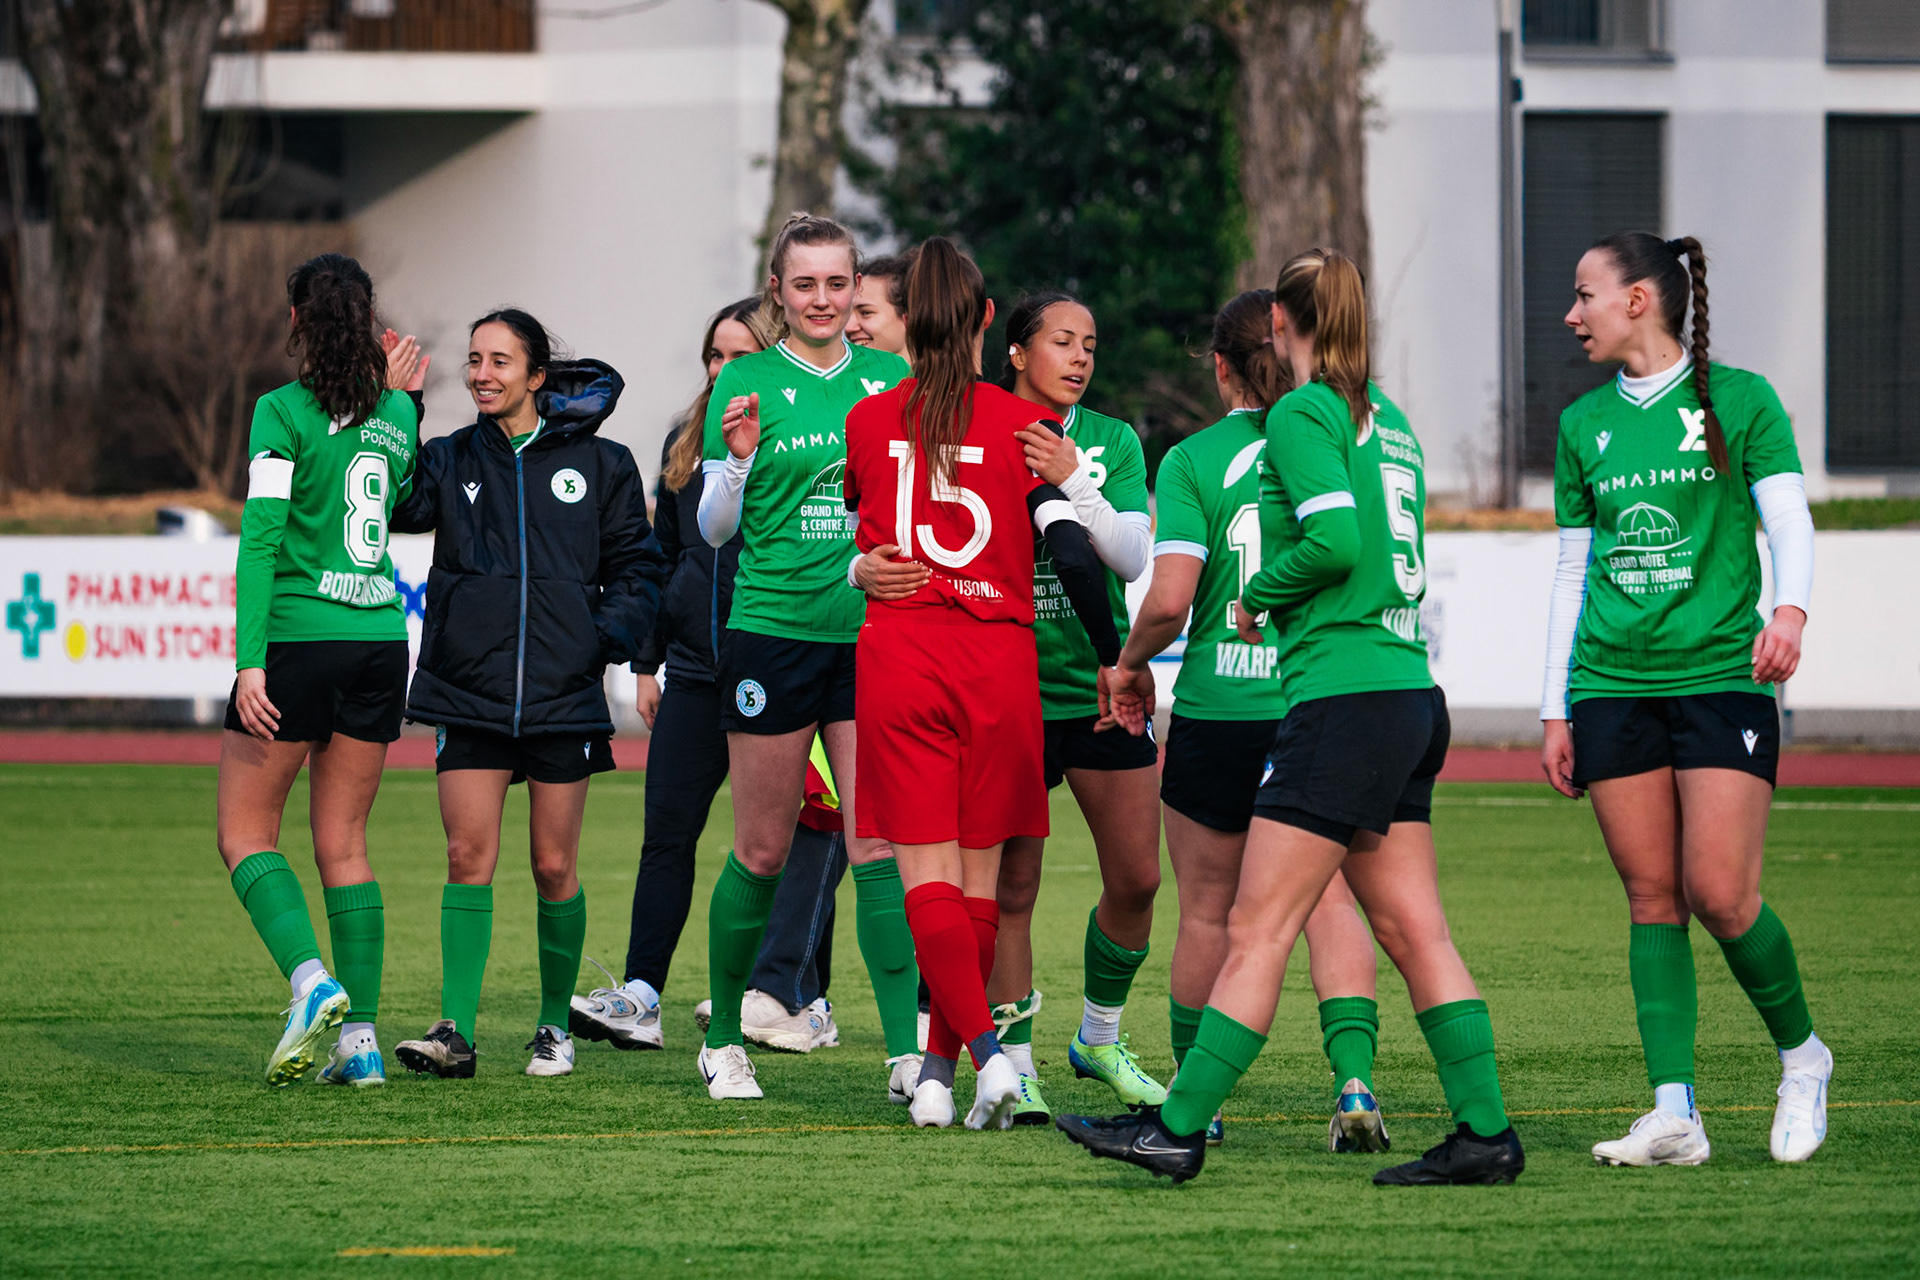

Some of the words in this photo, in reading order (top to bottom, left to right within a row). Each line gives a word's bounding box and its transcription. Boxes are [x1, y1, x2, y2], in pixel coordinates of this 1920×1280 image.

[360, 429, 410, 463] Populaire
[774, 429, 846, 454] AMMA
[343, 451, 390, 568] 8
[800, 504, 832, 517] GRAND
[888, 440, 992, 568] 15
[801, 519, 809, 531] &
[810, 518, 843, 531] CENTRE
[1379, 462, 1427, 602] 5
[1609, 556, 1638, 570] GRAND
[1638, 551, 1668, 568] HÔTEL
[1617, 571, 1648, 585] CENTRE
[1649, 566, 1694, 584] THERMAL
[1033, 597, 1060, 611] ENTRE
[94, 624, 147, 660] SUN
[1214, 641, 1281, 680] WARP
